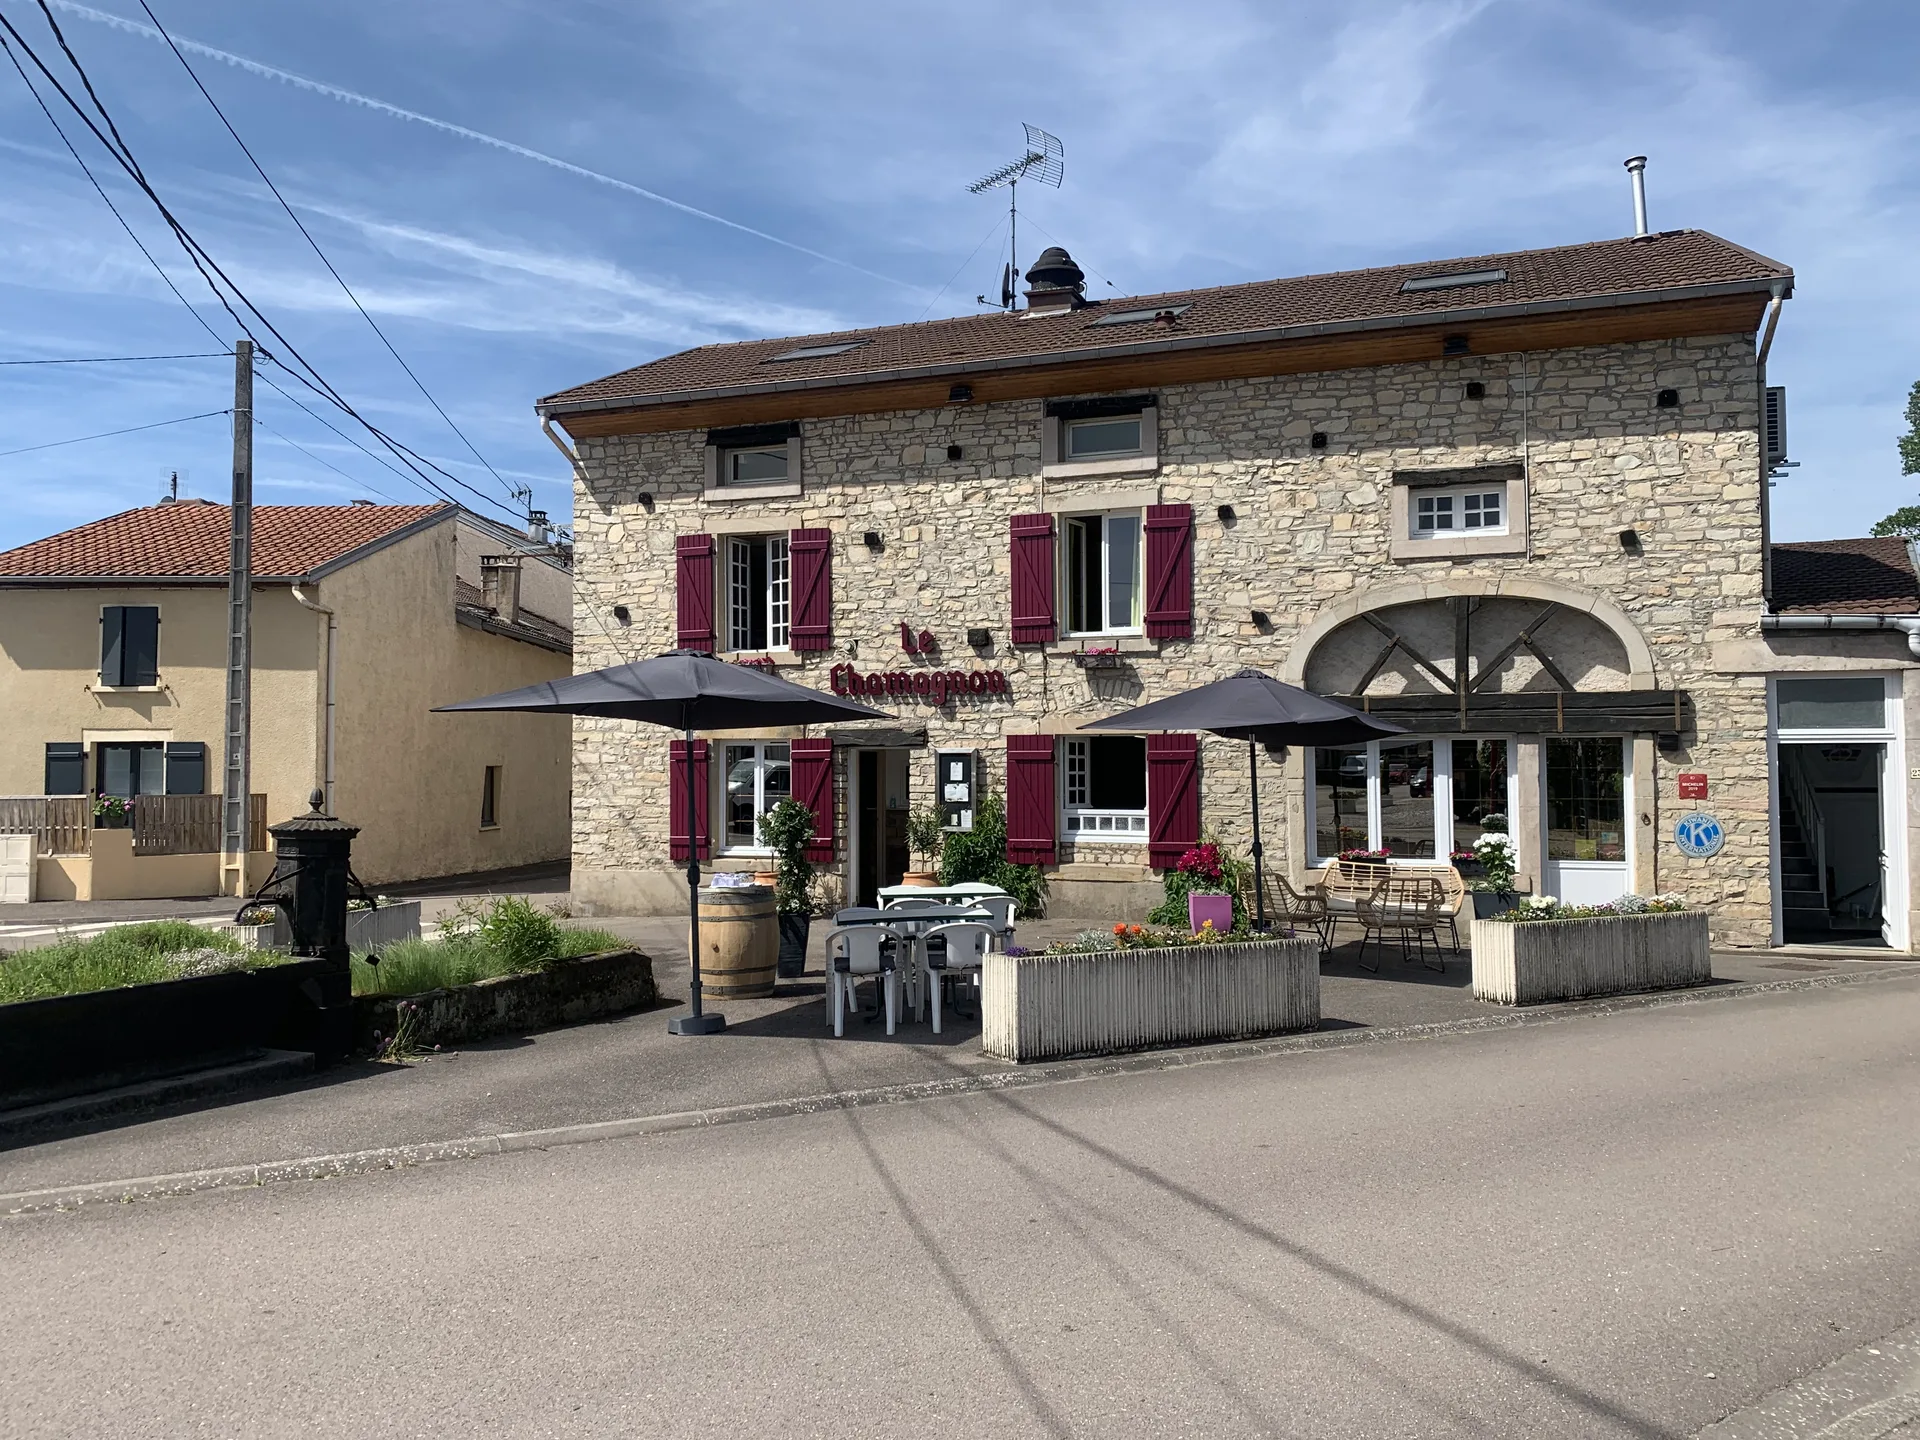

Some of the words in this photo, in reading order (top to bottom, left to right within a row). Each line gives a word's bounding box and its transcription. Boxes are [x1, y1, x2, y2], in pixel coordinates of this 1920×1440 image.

[901, 621, 936, 655] Le
[830, 662, 1006, 706] Chamagnon
[1683, 817, 1713, 827] KIWANIS
[1679, 834, 1719, 853] INTERNATIONAL
[1690, 823, 1709, 847] K
